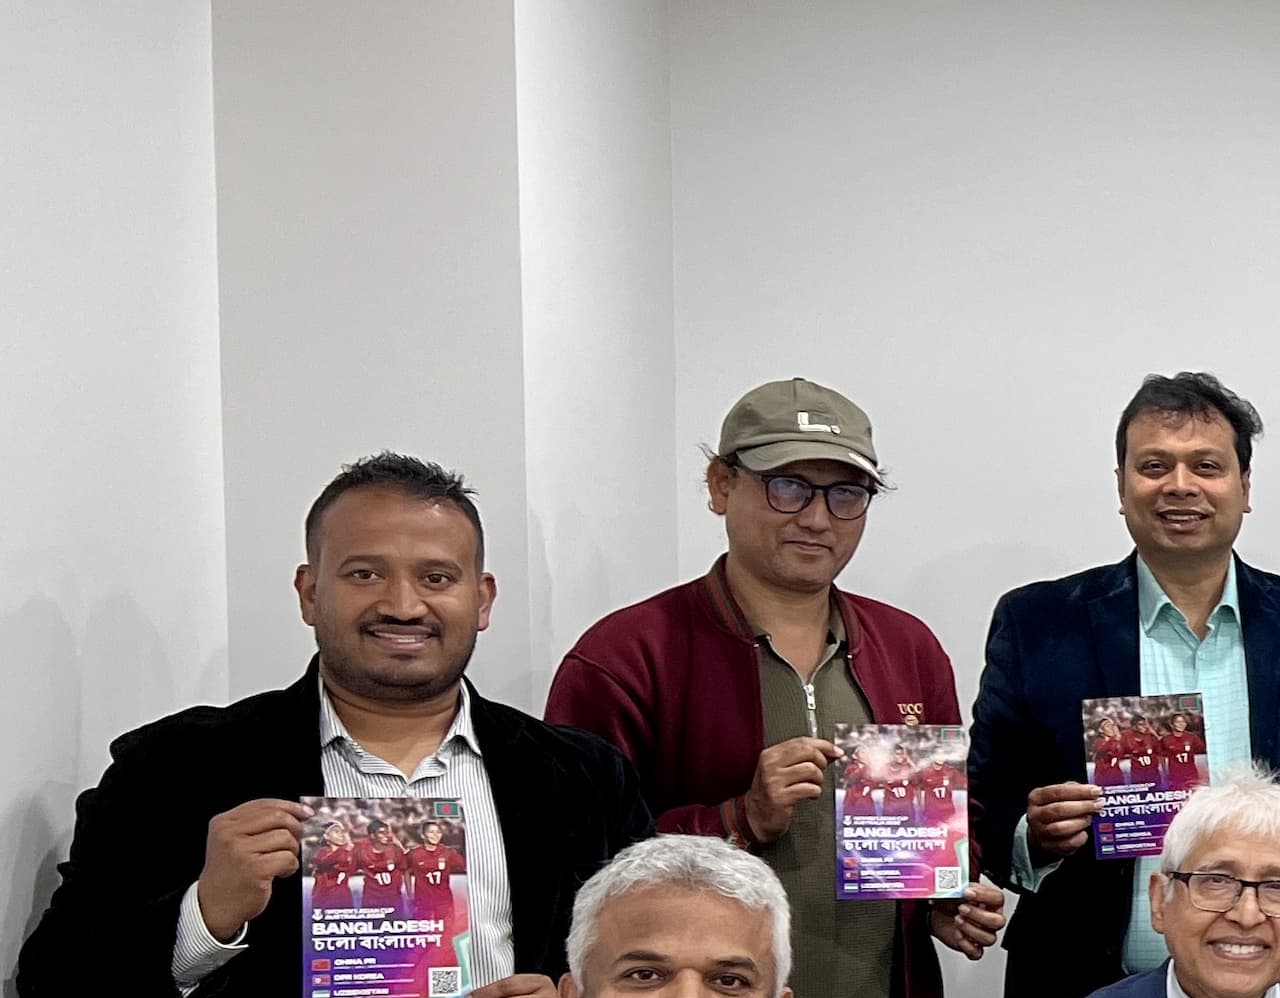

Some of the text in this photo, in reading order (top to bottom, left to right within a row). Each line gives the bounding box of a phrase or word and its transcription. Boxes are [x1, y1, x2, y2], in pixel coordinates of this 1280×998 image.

[897, 703, 924, 715] UCC
[843, 827, 948, 838] BANGLADESH
[312, 920, 444, 935] BANGLADESH
